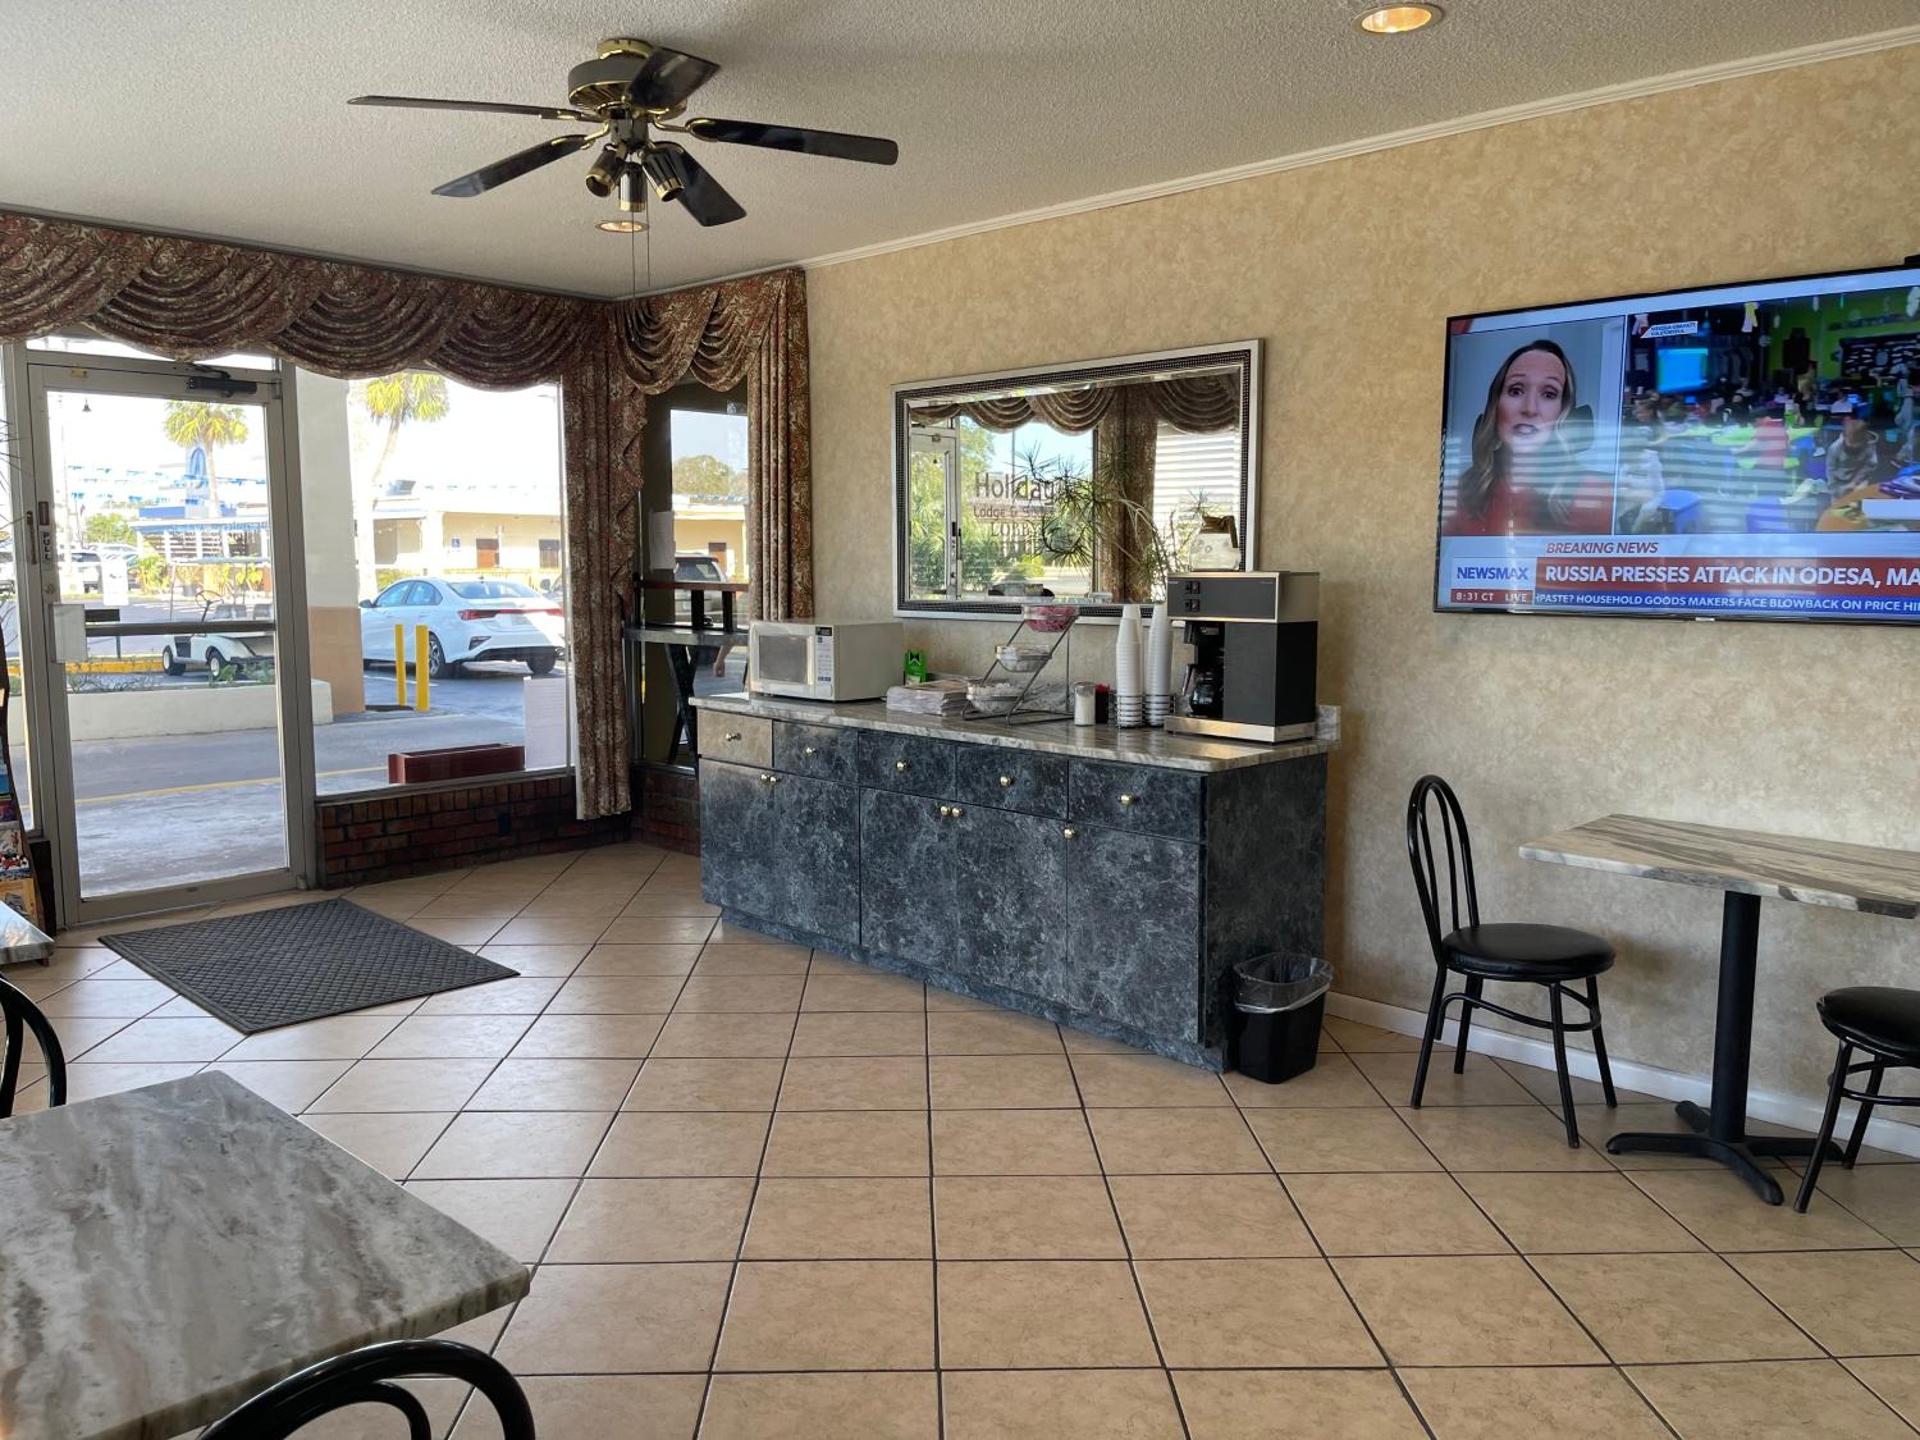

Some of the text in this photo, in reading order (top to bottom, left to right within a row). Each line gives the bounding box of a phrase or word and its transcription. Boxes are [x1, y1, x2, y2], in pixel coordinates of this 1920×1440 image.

[1546, 541, 1659, 554] BREAKING NEWS
[1456, 566, 1529, 580] NEWSMAX
[1545, 565, 1920, 588] RUSSIA PRESSES ATTACK IN ODESA, MA
[1455, 592, 1495, 601] 8:31 CT
[1505, 593, 1527, 602] LIVE
[1576, 594, 1643, 605] HOUSEHOLD
[1645, 595, 1687, 606] GOODS
[1688, 597, 1736, 607] MAKERS
[1737, 598, 1767, 608] FACE
[1769, 598, 1839, 609] BLOWBACK
[1841, 600, 1863, 610] ON
[1865, 600, 1901, 611] PRICE
